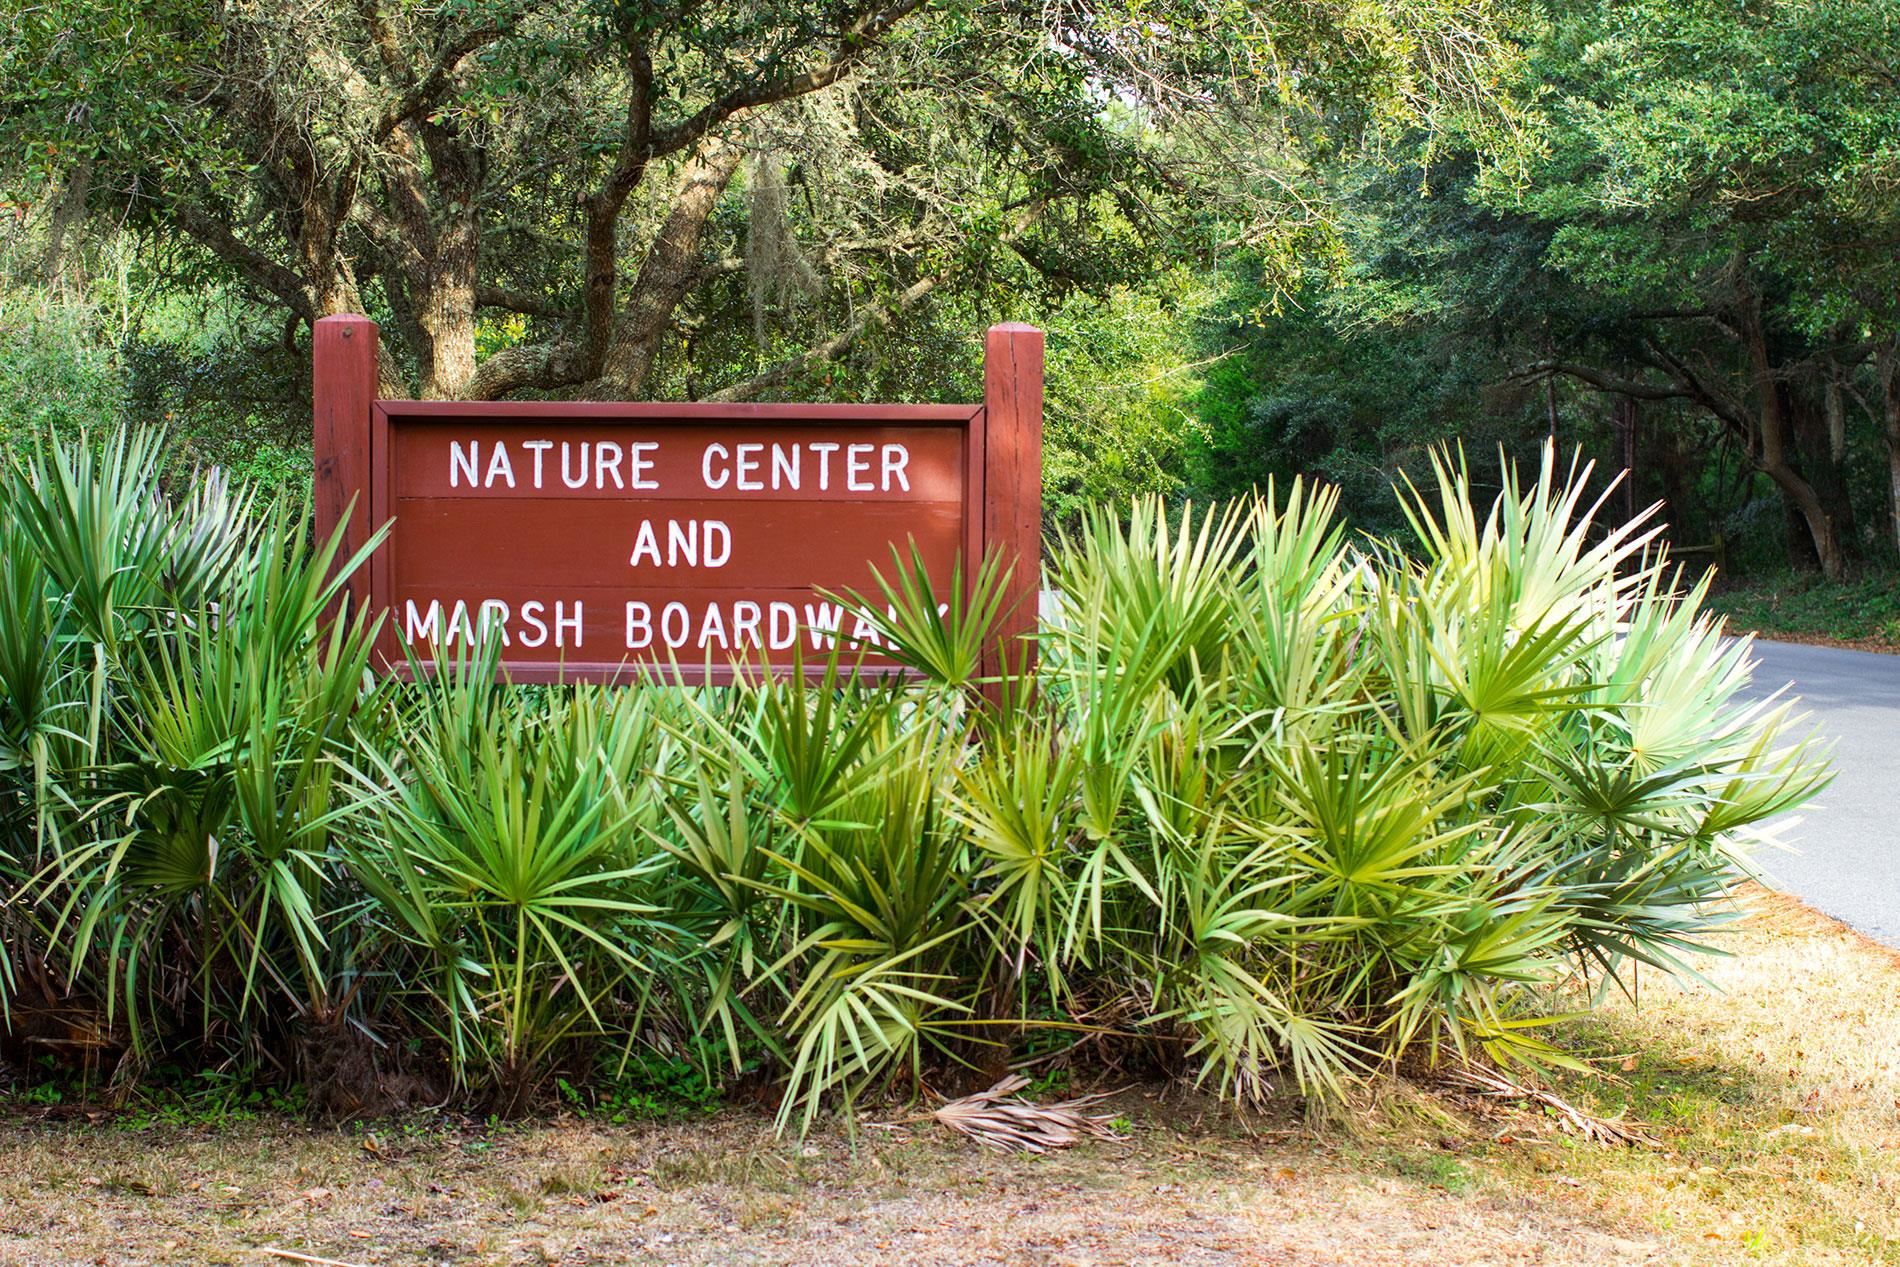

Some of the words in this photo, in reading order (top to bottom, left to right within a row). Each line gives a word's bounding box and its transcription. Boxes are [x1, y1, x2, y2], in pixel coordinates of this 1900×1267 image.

[449, 440, 660, 490] NATURE
[701, 442, 911, 493] CENTER
[629, 519, 732, 568] AND
[405, 599, 583, 648] MARSH
[625, 600, 949, 651] BOARDWA
